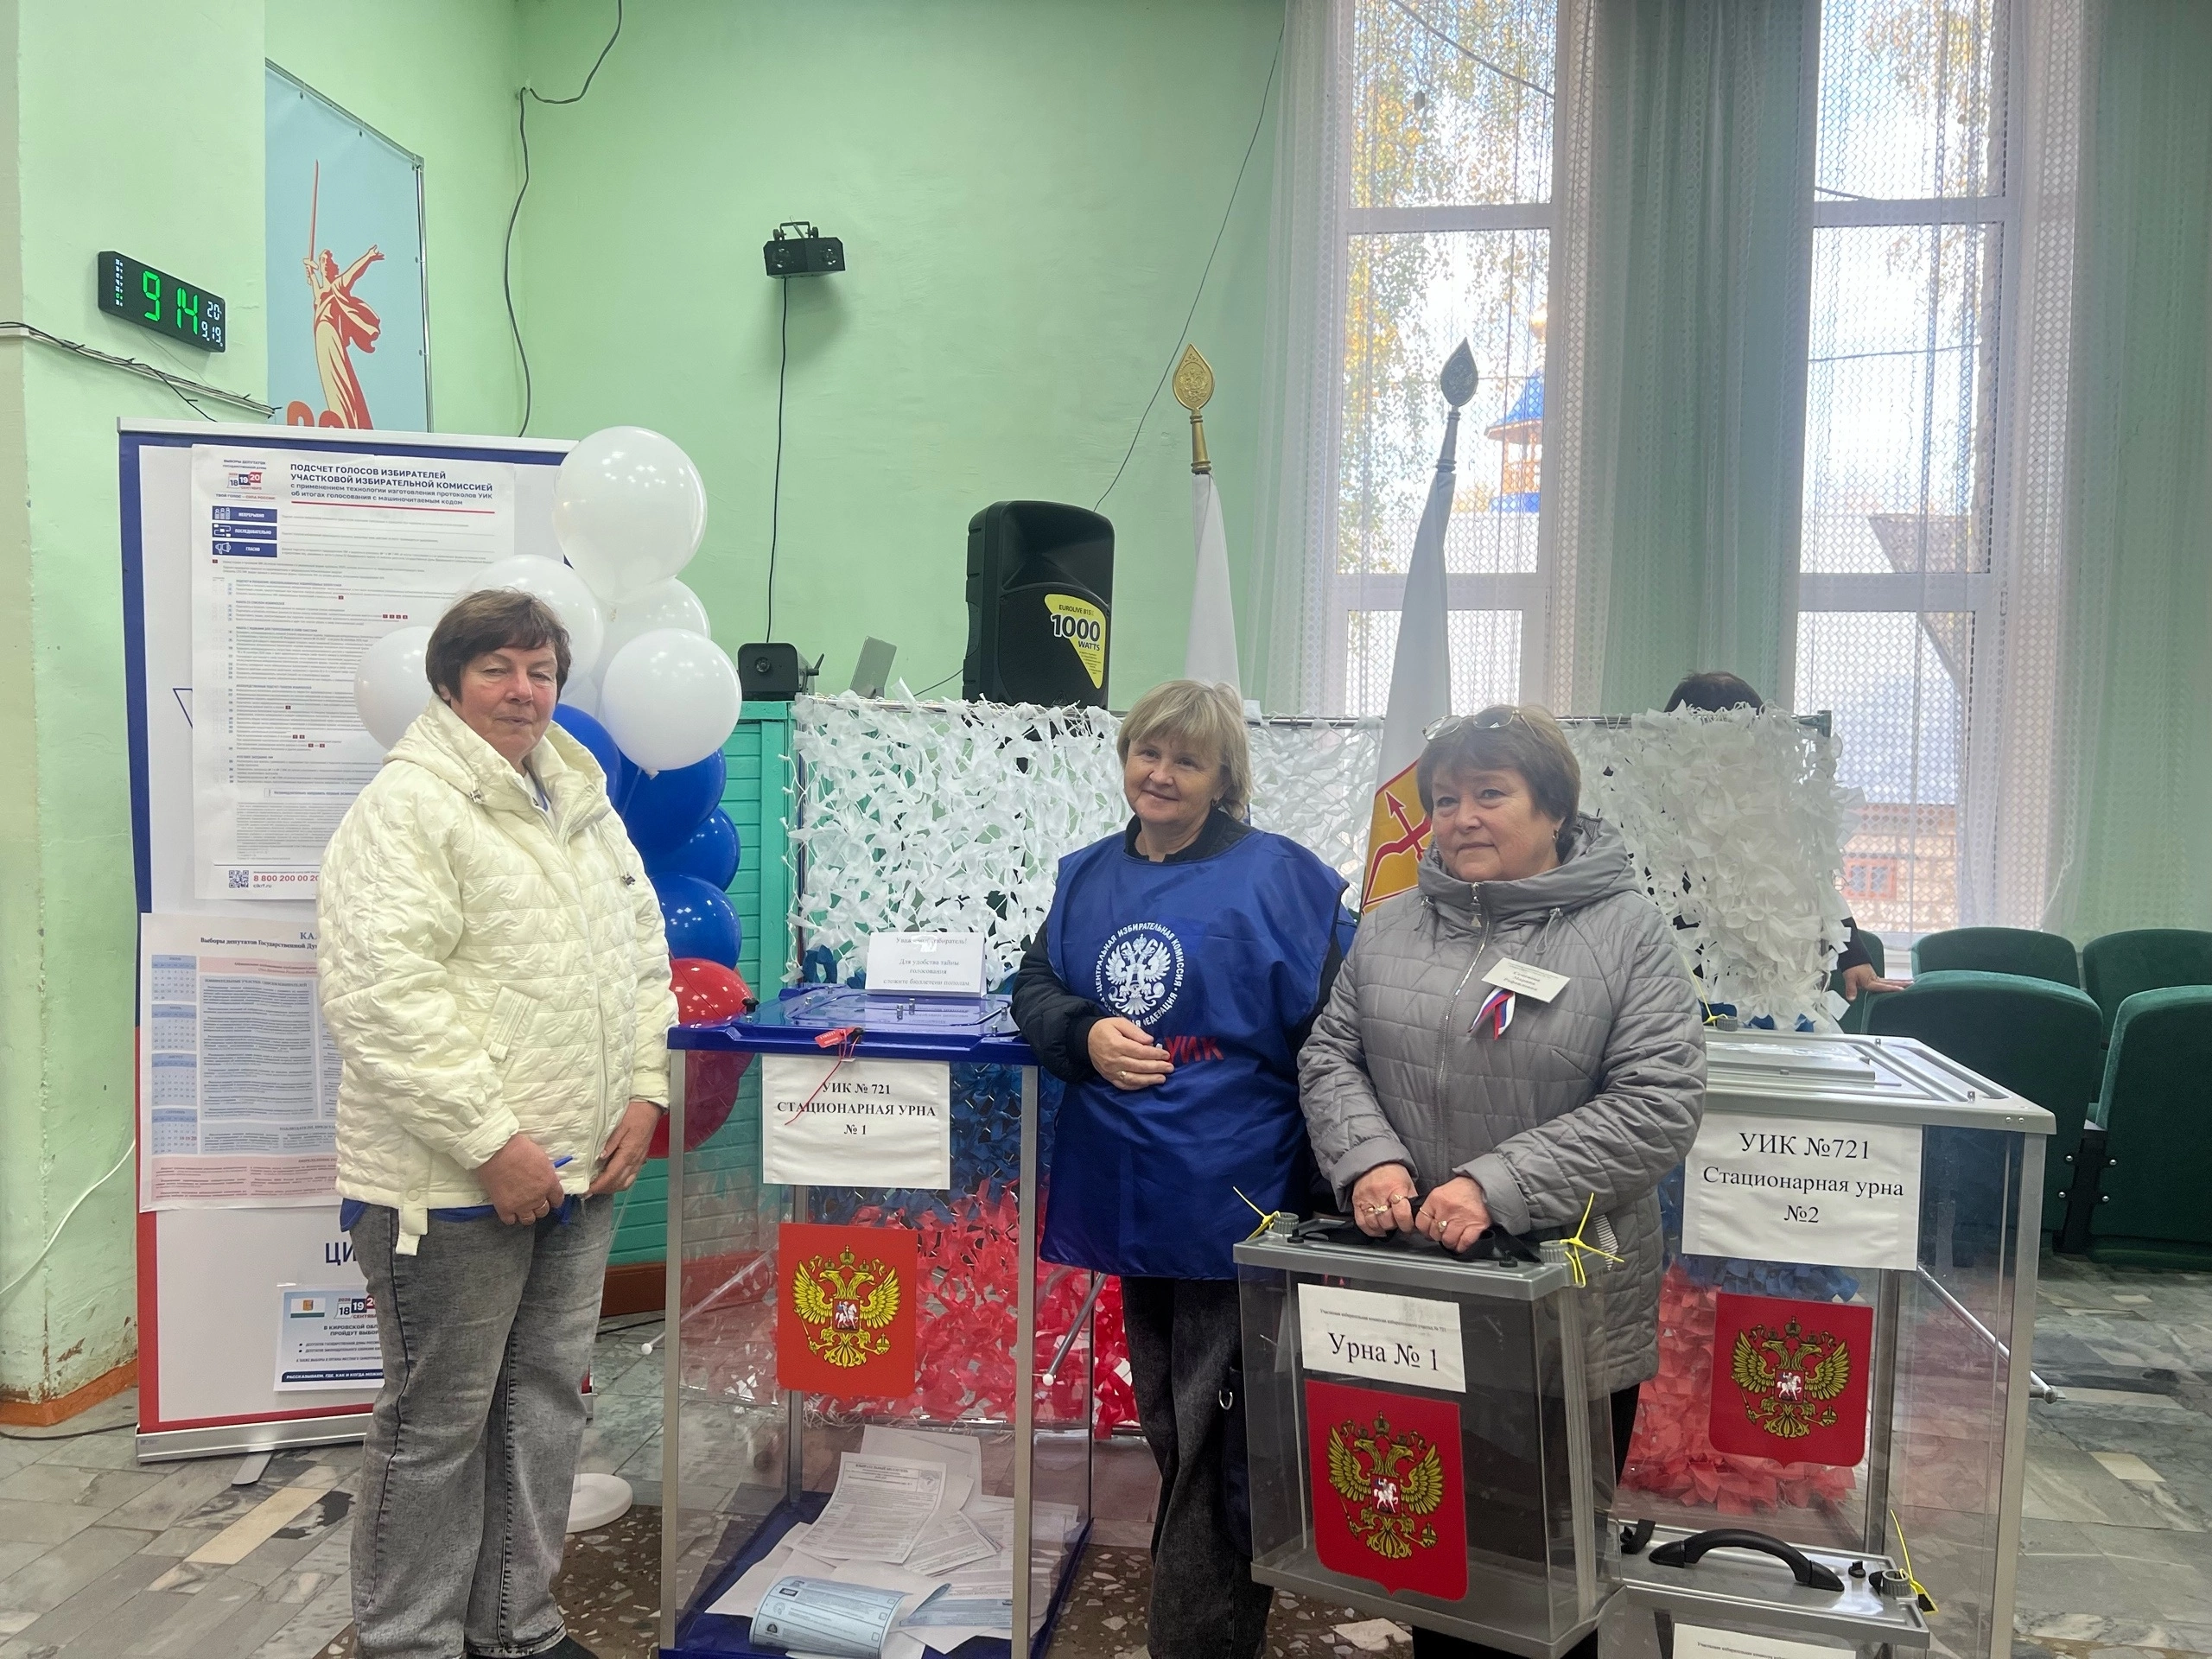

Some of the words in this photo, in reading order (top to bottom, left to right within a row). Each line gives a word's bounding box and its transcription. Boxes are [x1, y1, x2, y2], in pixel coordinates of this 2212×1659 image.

[290, 464, 334, 473] ПОДСЧЕТ
[336, 467, 378, 475] ГОЛОСОВ
[381, 469, 446, 479] ИЗБИРАТЕЛЕЙ
[290, 474, 353, 484] УЧАСТКОВОЙ
[356, 478, 434, 488] ИЗБИРАТЕЛЬНОЙ
[436, 482, 493, 491] КОМИССИЕЙ
[378, 496, 440, 505] машиночитаемым
[1059, 604, 1083, 613] EUROLIVE
[1052, 614, 1101, 642] 1000
[1078, 641, 1100, 652] WATTS
[258, 940, 305, 949] Государственной
[1095, 934, 1117, 993] ЦЕНТРАЛЬНАЯ
[1117, 922, 1175, 941] ИЗБИРАТЕЛЬНАЯ
[1171, 938, 1185, 988] КОМИССИЯ
[1165, 1035, 1224, 1064] УИК
[823, 1082, 851, 1094] УИК
[855, 1084, 868, 1094] №
[871, 1084, 891, 1095] 721
[778, 1101, 894, 1116] СТАЦИОНАРНАЯ
[899, 1104, 936, 1116] УРНА
[843, 1124, 858, 1135] №
[861, 1125, 867, 1135] 1
[1738, 1132, 1797, 1155] УИК
[1804, 1137, 1870, 1160] №721
[1703, 1166, 1849, 1194] Стационарная
[1855, 1180, 1904, 1198] урна
[1783, 1205, 1820, 1224] №2
[325, 1242, 358, 1266] ЦИ
[366, 1298, 375, 1306] 2
[1328, 1332, 1386, 1363] Урна
[1395, 1343, 1421, 1369] №
[1430, 1349, 1439, 1371] 1
